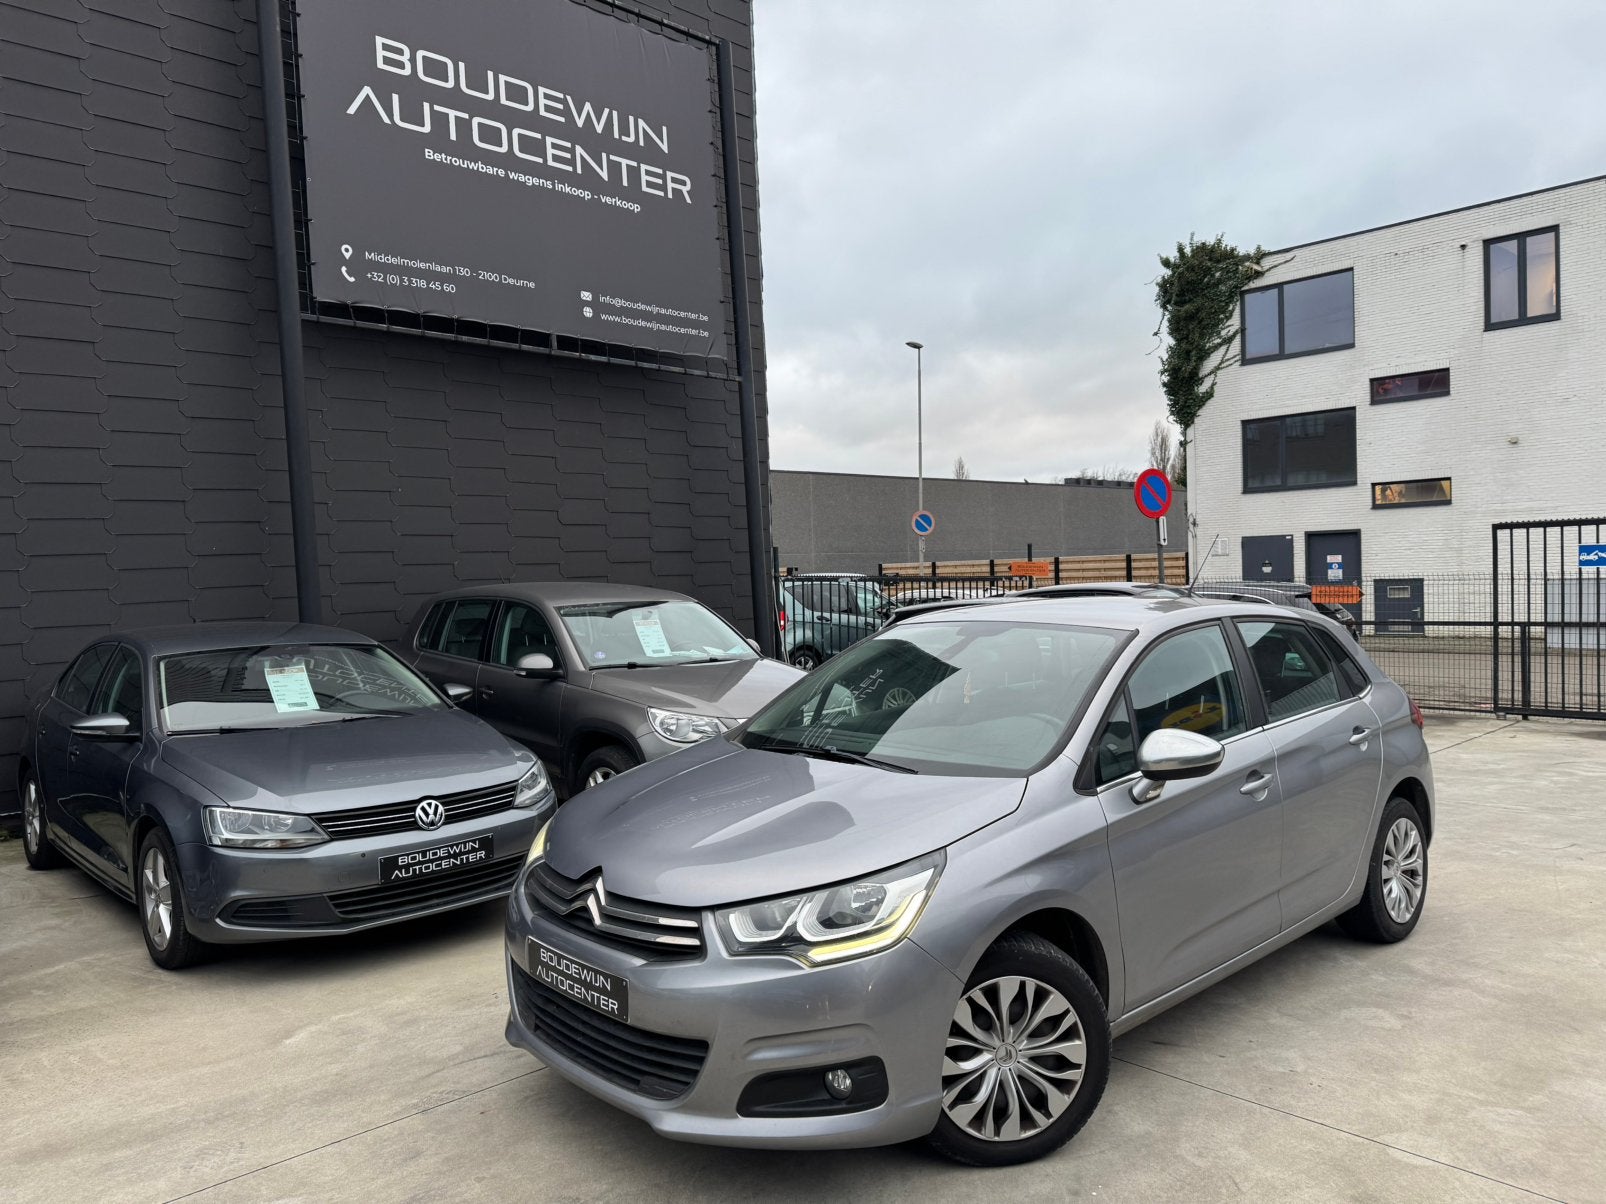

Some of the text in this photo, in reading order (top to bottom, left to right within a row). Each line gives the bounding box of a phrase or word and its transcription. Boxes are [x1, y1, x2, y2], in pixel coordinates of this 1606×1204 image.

[375, 35, 669, 154] BOUDEWIJN
[346, 85, 692, 204] AUTOCENTER
[424, 148, 505, 177] Betrouwbare
[508, 169, 553, 190] wagens
[555, 180, 592, 201] inkoop
[600, 193, 641, 213] verkoop
[365, 251, 453, 273] Middelmolenlaan
[455, 266, 471, 278] 130
[478, 270, 499, 282] 2100
[501, 275, 536, 289] Deurne
[366, 272, 456, 294] +32 (0) 3 318 45 60
[599, 294, 709, 322] info@boudewijnautocenter.be
[600, 312, 709, 338] www.boudewijnautocenter.be
[391, 850, 486, 880] AUTOCENTER
[398, 840, 479, 866] BOUDEWIJN
[540, 948, 611, 992] BOUDEWIJN
[536, 965, 618, 1015] AUTOCENTER
